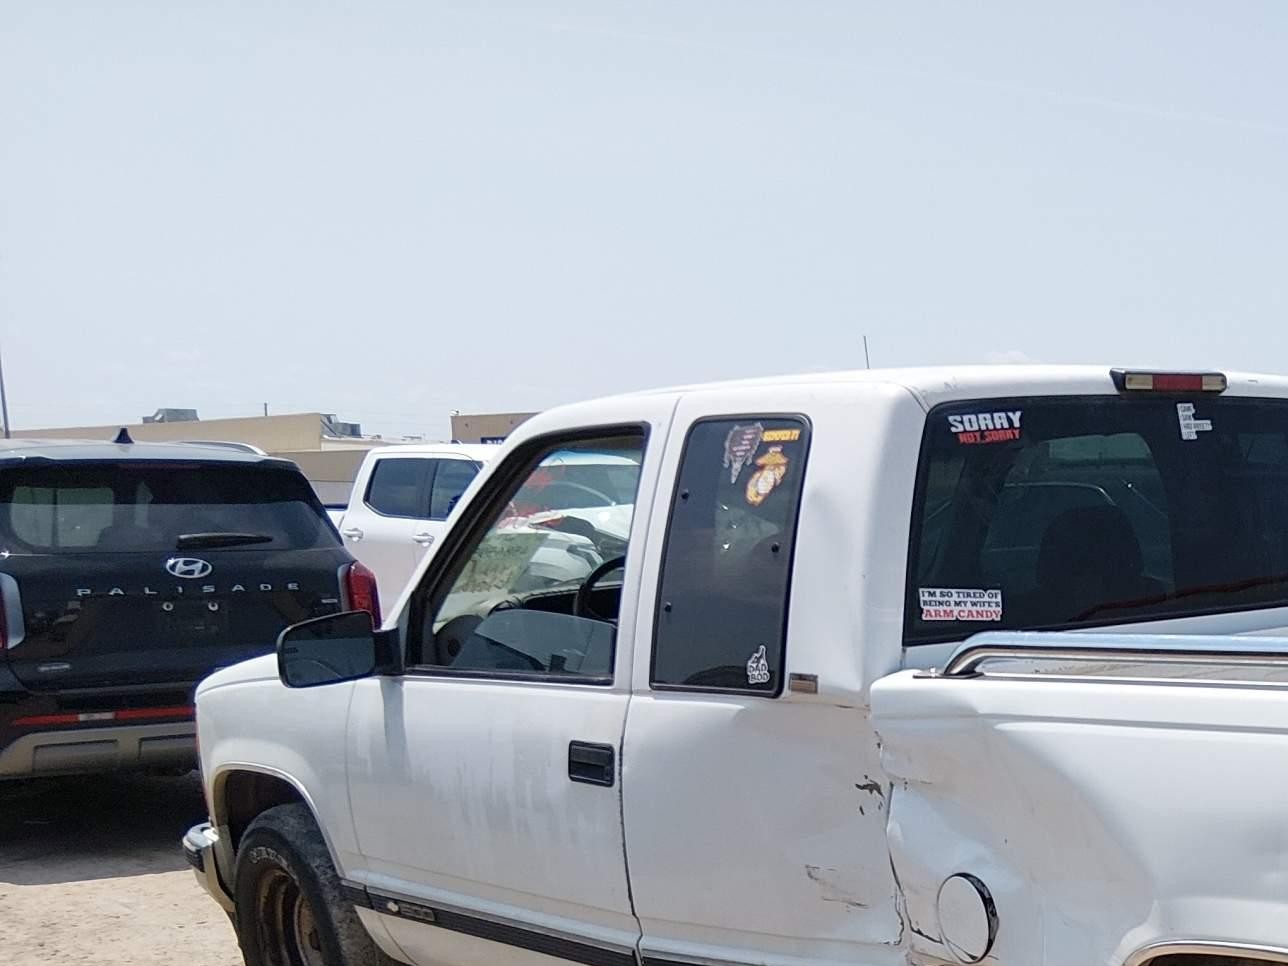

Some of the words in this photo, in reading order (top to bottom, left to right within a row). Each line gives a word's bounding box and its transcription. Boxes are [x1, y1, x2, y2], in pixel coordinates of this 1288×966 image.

[948, 411, 1022, 432] SORRY
[959, 431, 980, 443] NOT
[984, 429, 1020, 441] SORRY
[76, 583, 300, 597] PALISADE
[921, 590, 936, 598] I'M
[955, 591, 985, 599] TIRED
[924, 609, 954, 618] ARM
[958, 610, 1001, 618] CANDY
[749, 663, 767, 672] DAD
[750, 672, 769, 681] BOD
